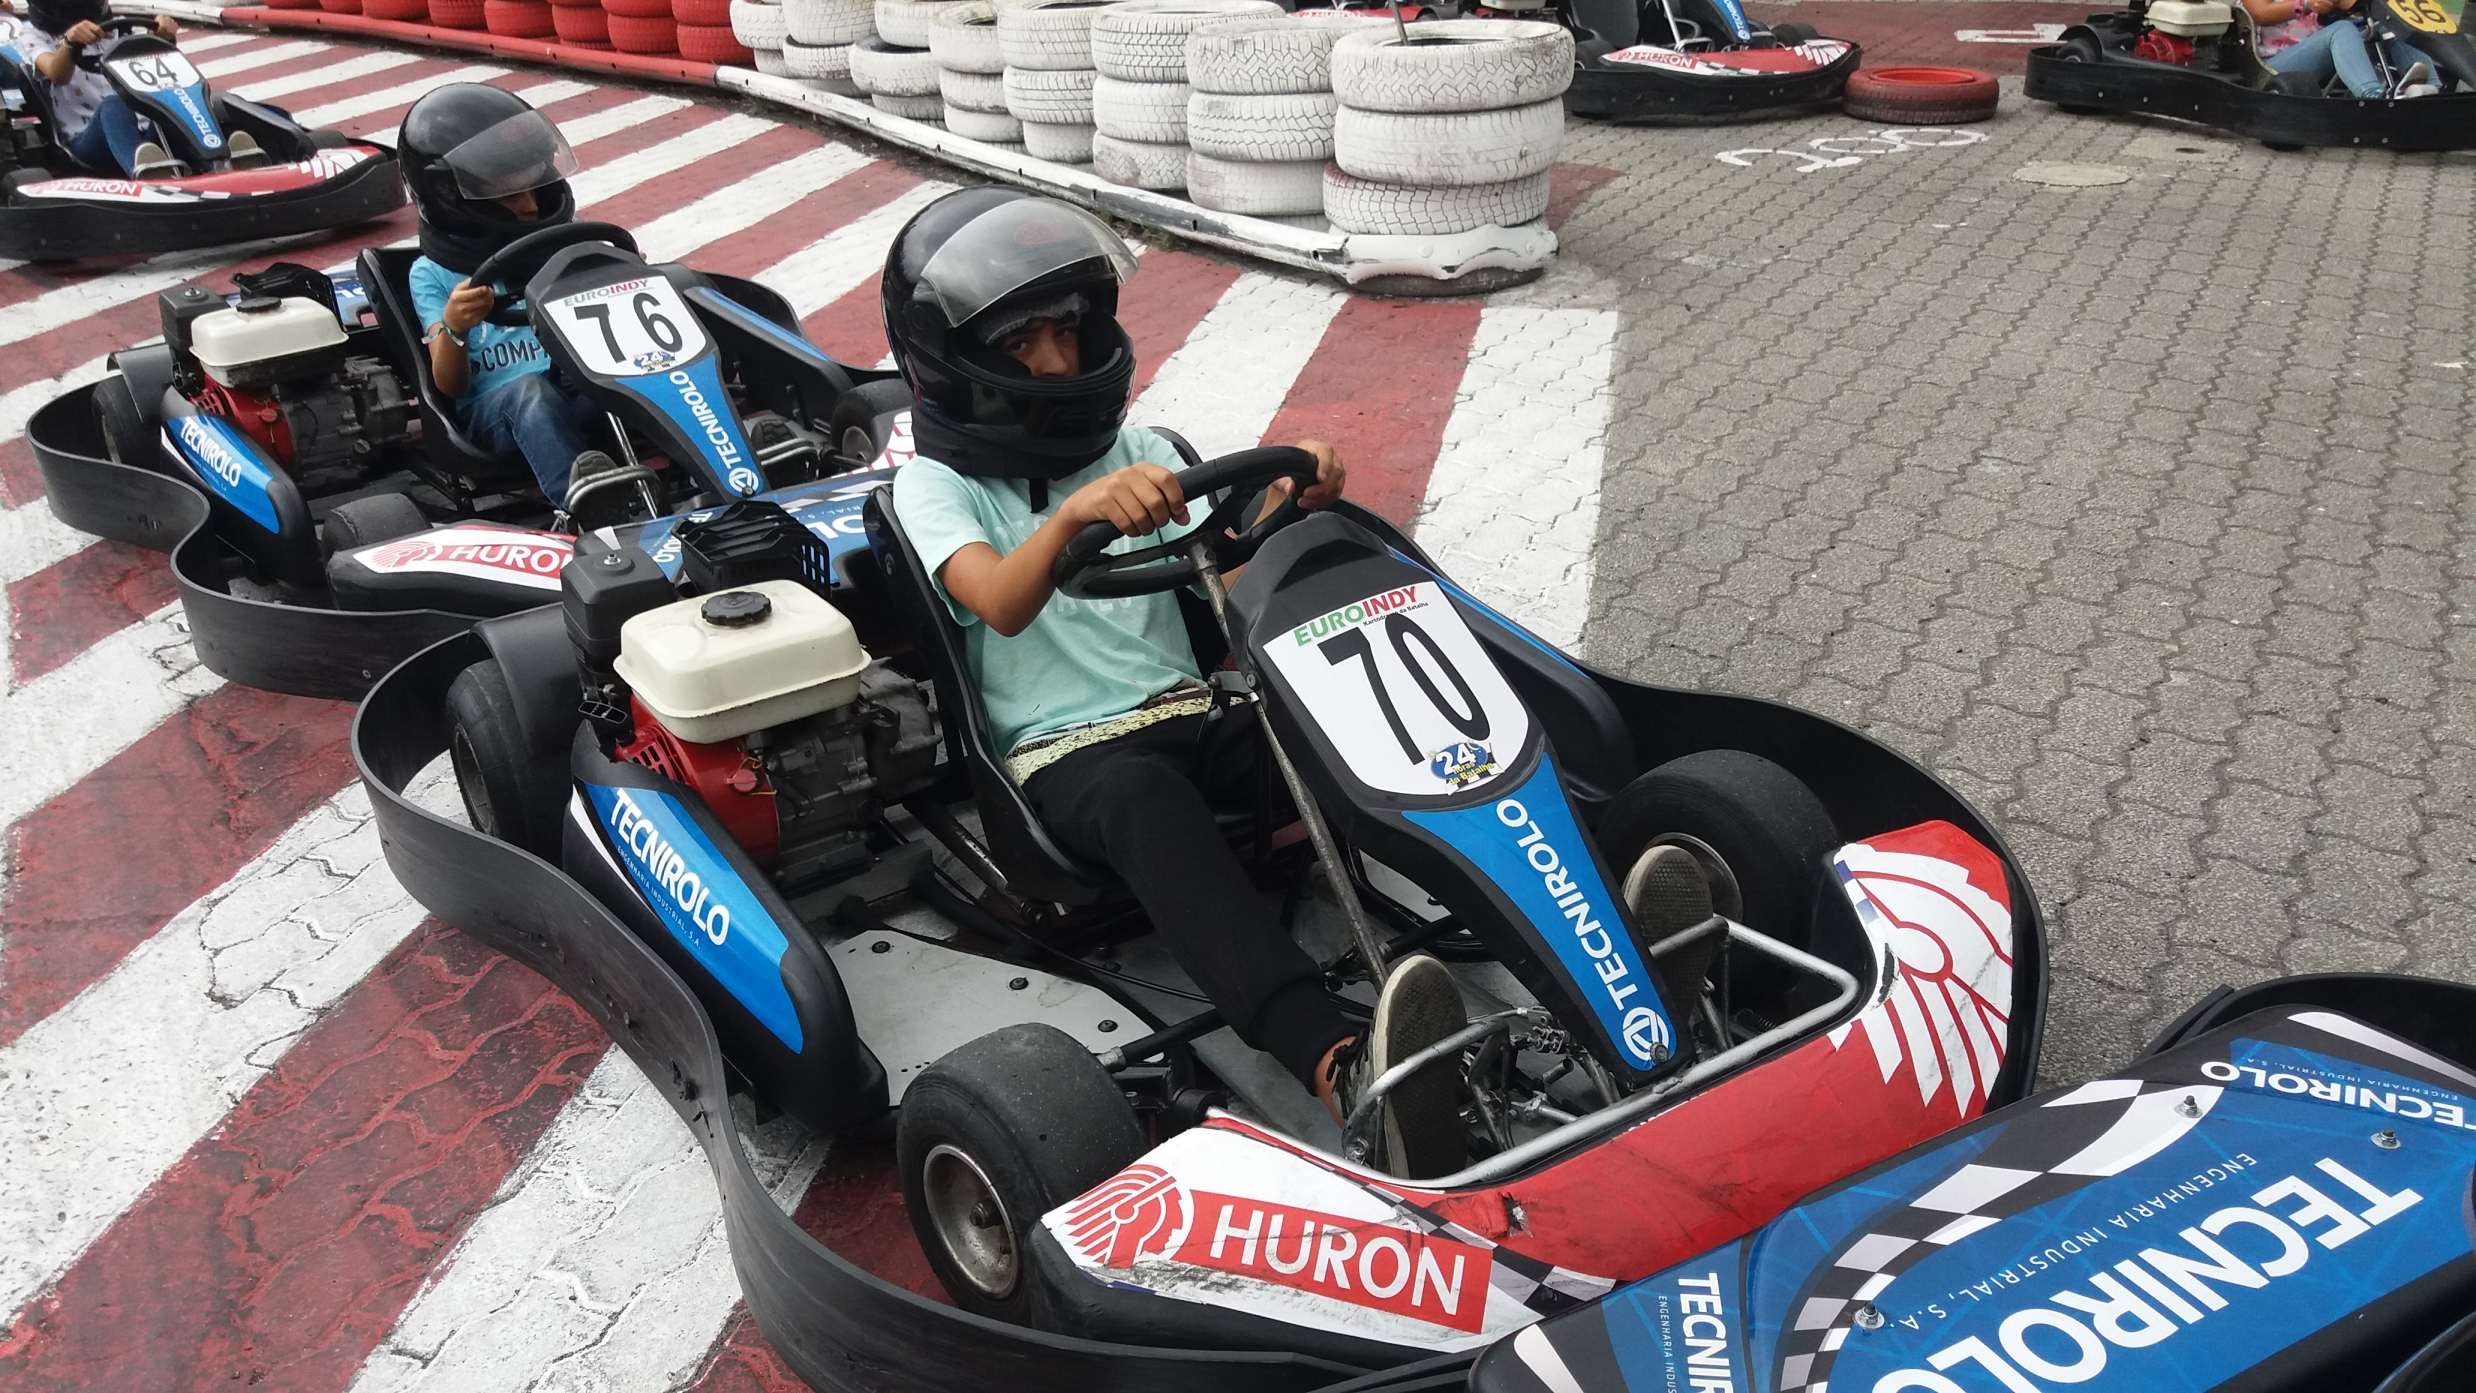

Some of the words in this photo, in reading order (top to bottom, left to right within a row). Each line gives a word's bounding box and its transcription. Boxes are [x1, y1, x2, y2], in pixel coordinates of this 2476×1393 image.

[128, 58, 177, 86] 64
[1639, 52, 1692, 68] HURON
[64, 182, 137, 195] HURON
[564, 279, 649, 307] EUROINDY
[574, 293, 683, 363] 76
[181, 416, 242, 487] TECNIROLO
[669, 370, 742, 469] TECNIROLO
[1294, 586, 1417, 646] EUROINDY
[1317, 612, 1490, 765] 70
[1436, 743, 1476, 775] 24
[610, 788, 730, 946] TECNIROLO
[1496, 799, 1639, 1011] TECNIROLO
[2367, 1079, 2458, 1100] ENGENHARIA
[2108, 1153, 2258, 1229] ENGENHARIA
[1210, 1204, 1465, 1316] HURON
[1948, 1226, 2108, 1302] INDUSTRIAL,
[1659, 1295, 1673, 1358] ENGENHARIA
[1889, 1304, 1947, 1331] S.A.
